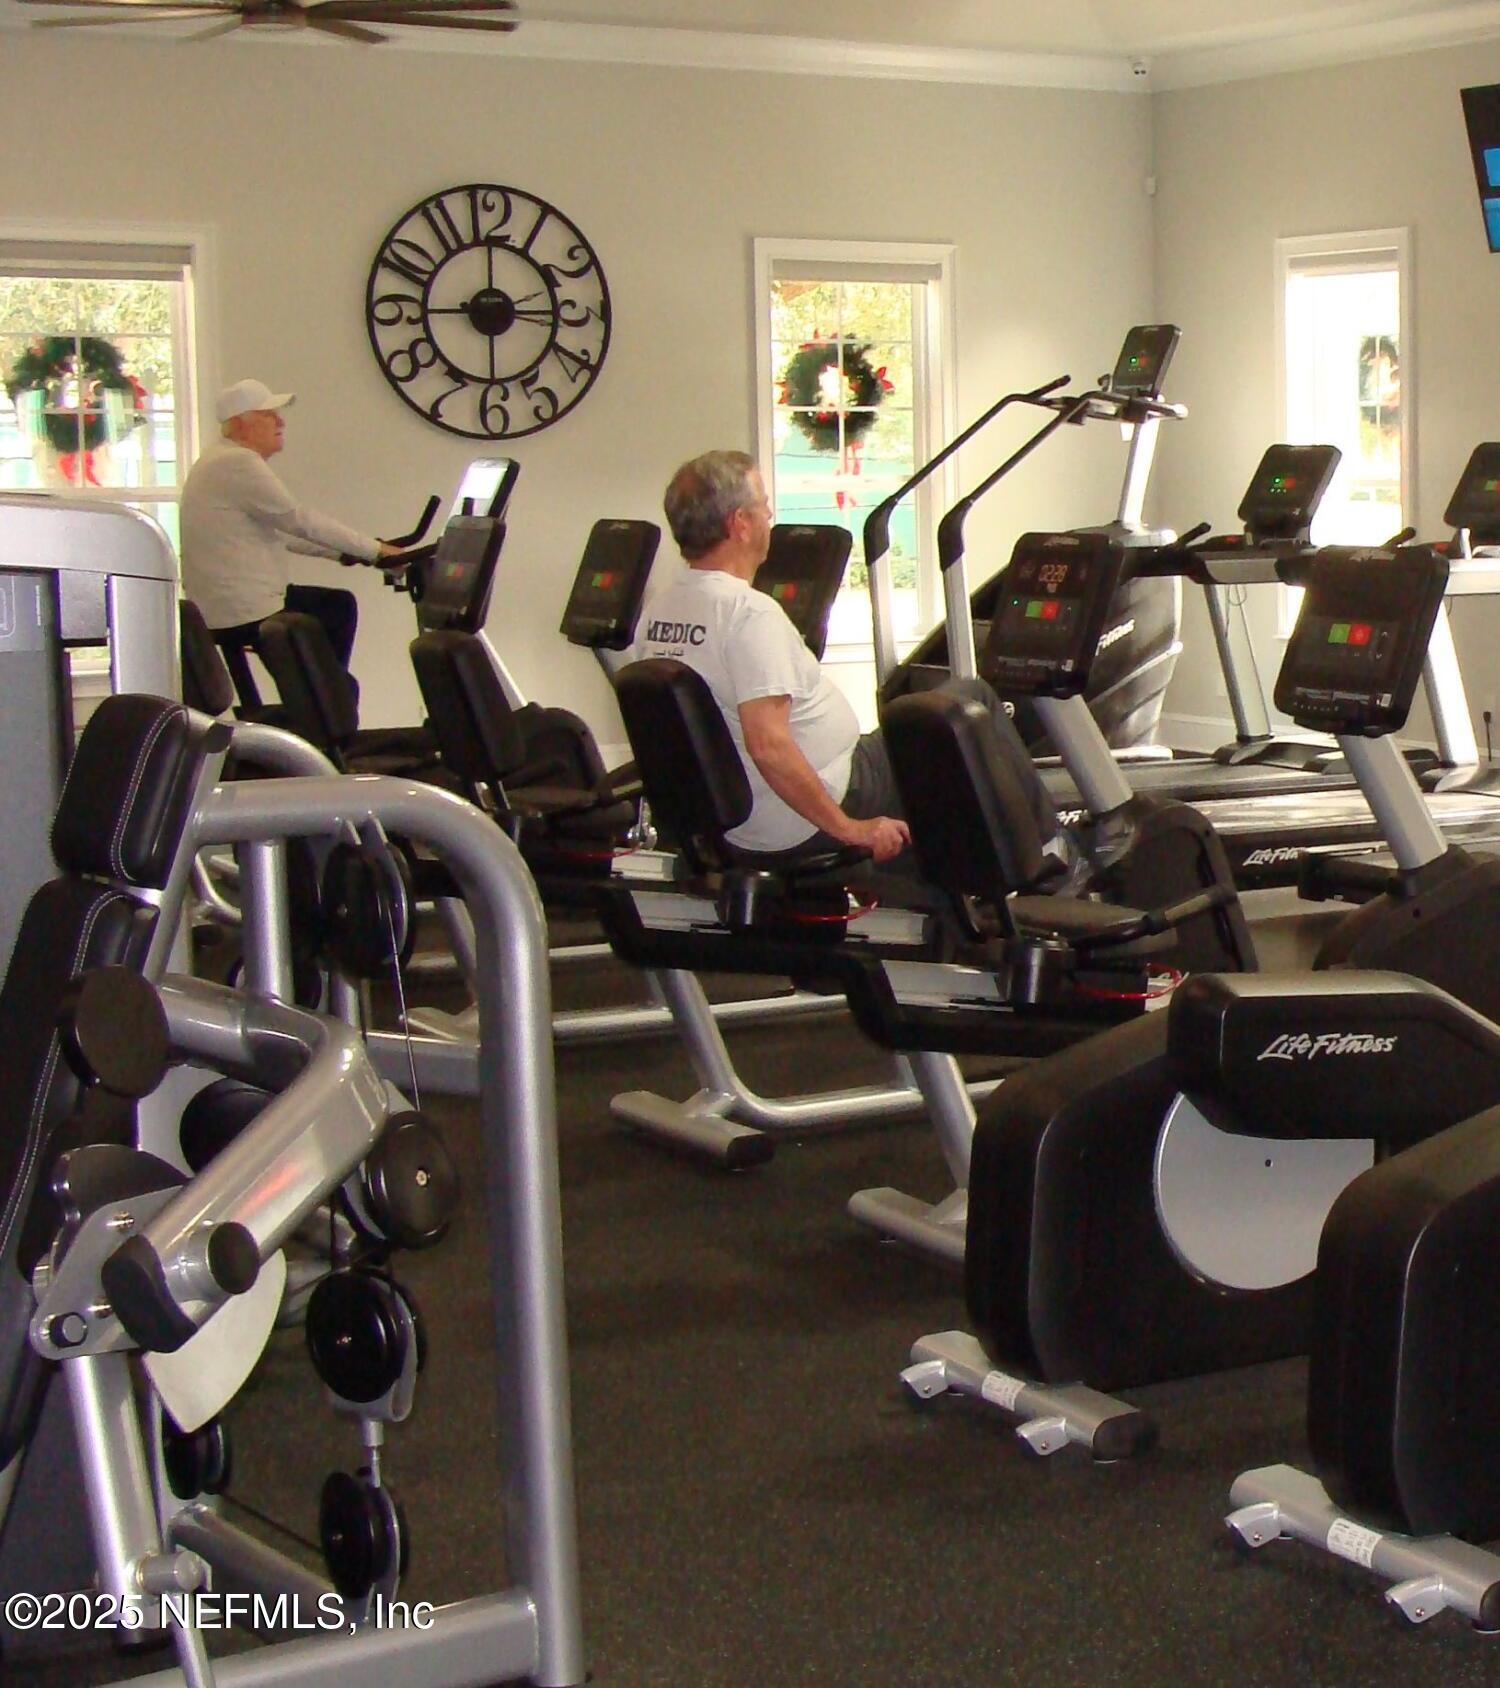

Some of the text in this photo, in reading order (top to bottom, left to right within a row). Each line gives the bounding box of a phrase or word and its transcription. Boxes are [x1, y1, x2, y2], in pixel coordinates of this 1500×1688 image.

[421, 198, 463, 254] 11
[471, 189, 512, 243] 12
[524, 204, 552, 252] 1
[381, 238, 437, 287] 10
[541, 244, 597, 288] 2
[373, 294, 424, 326] 9
[559, 299, 606, 328] 3
[387, 338, 438, 382] 8
[552, 342, 600, 383] 4
[430, 366, 468, 419] 7
[479, 383, 510, 435] 6
[520, 368, 559, 421] 5
